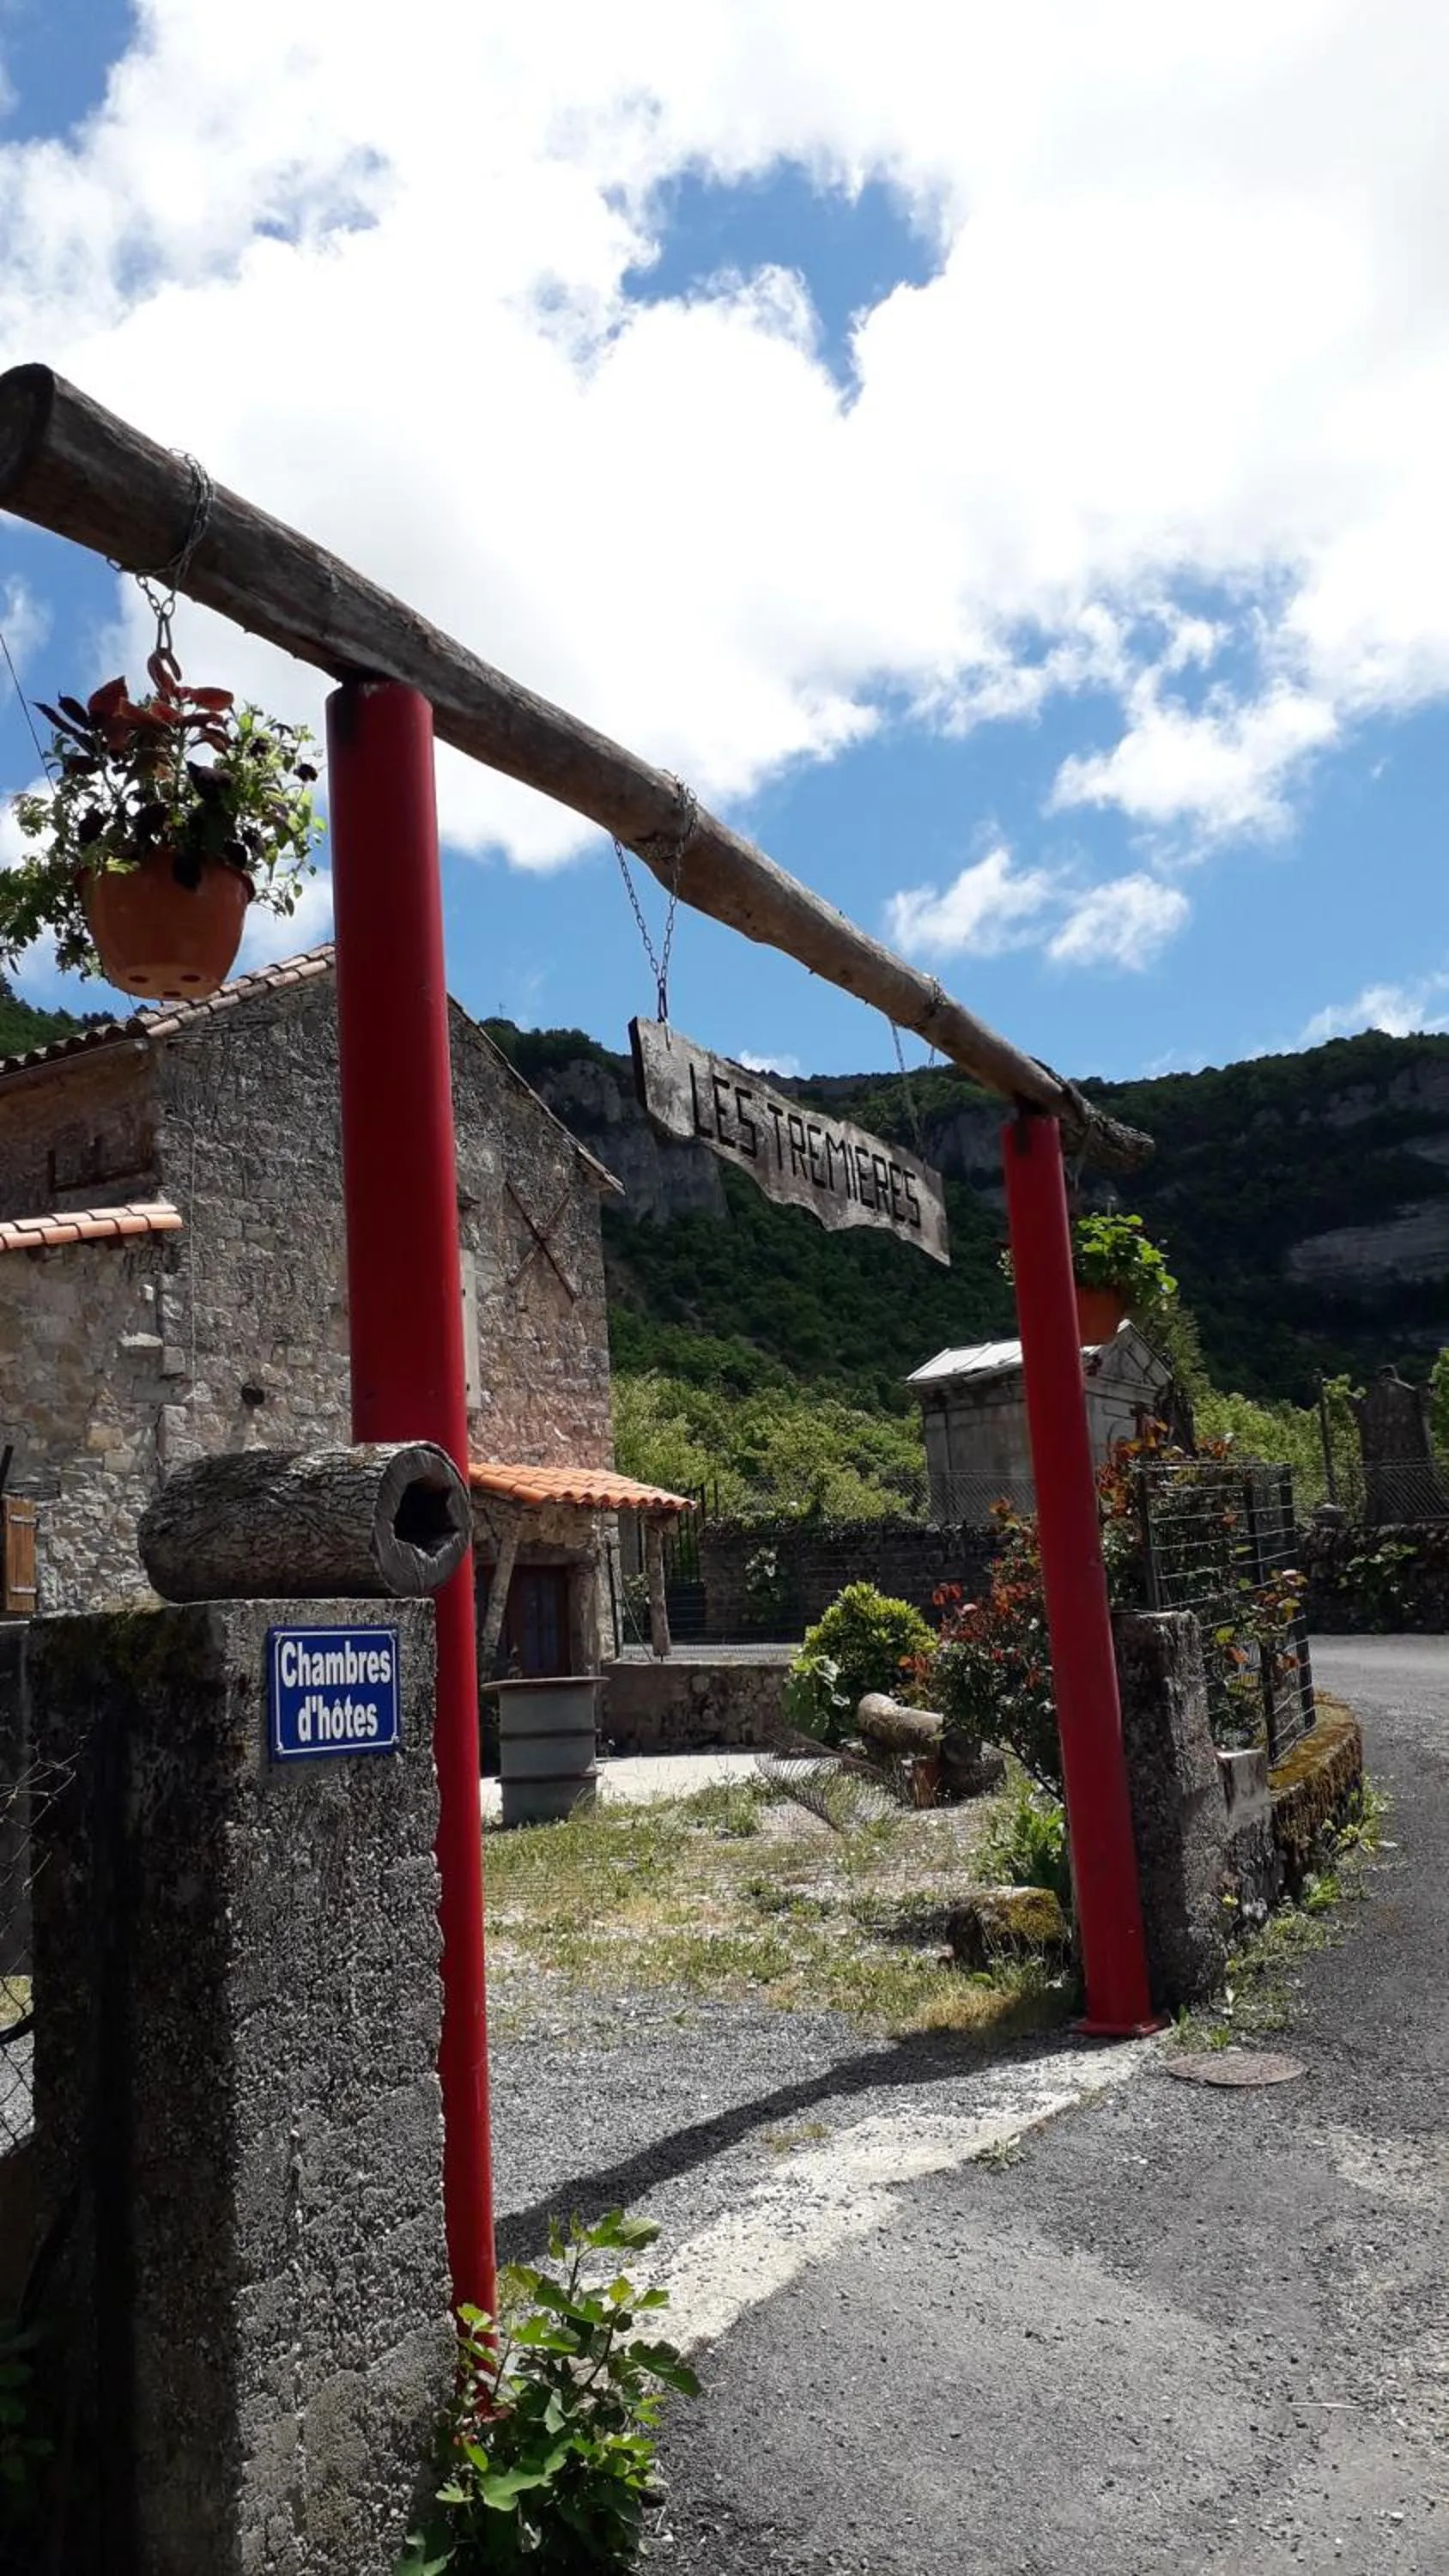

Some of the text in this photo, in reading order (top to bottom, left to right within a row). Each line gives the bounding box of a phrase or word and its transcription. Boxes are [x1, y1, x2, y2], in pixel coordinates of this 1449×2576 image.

[689, 1062, 920, 1228] LES TREMIERES
[281, 1640, 391, 1687] Chambres
[298, 1694, 378, 1741] d'hôtes
